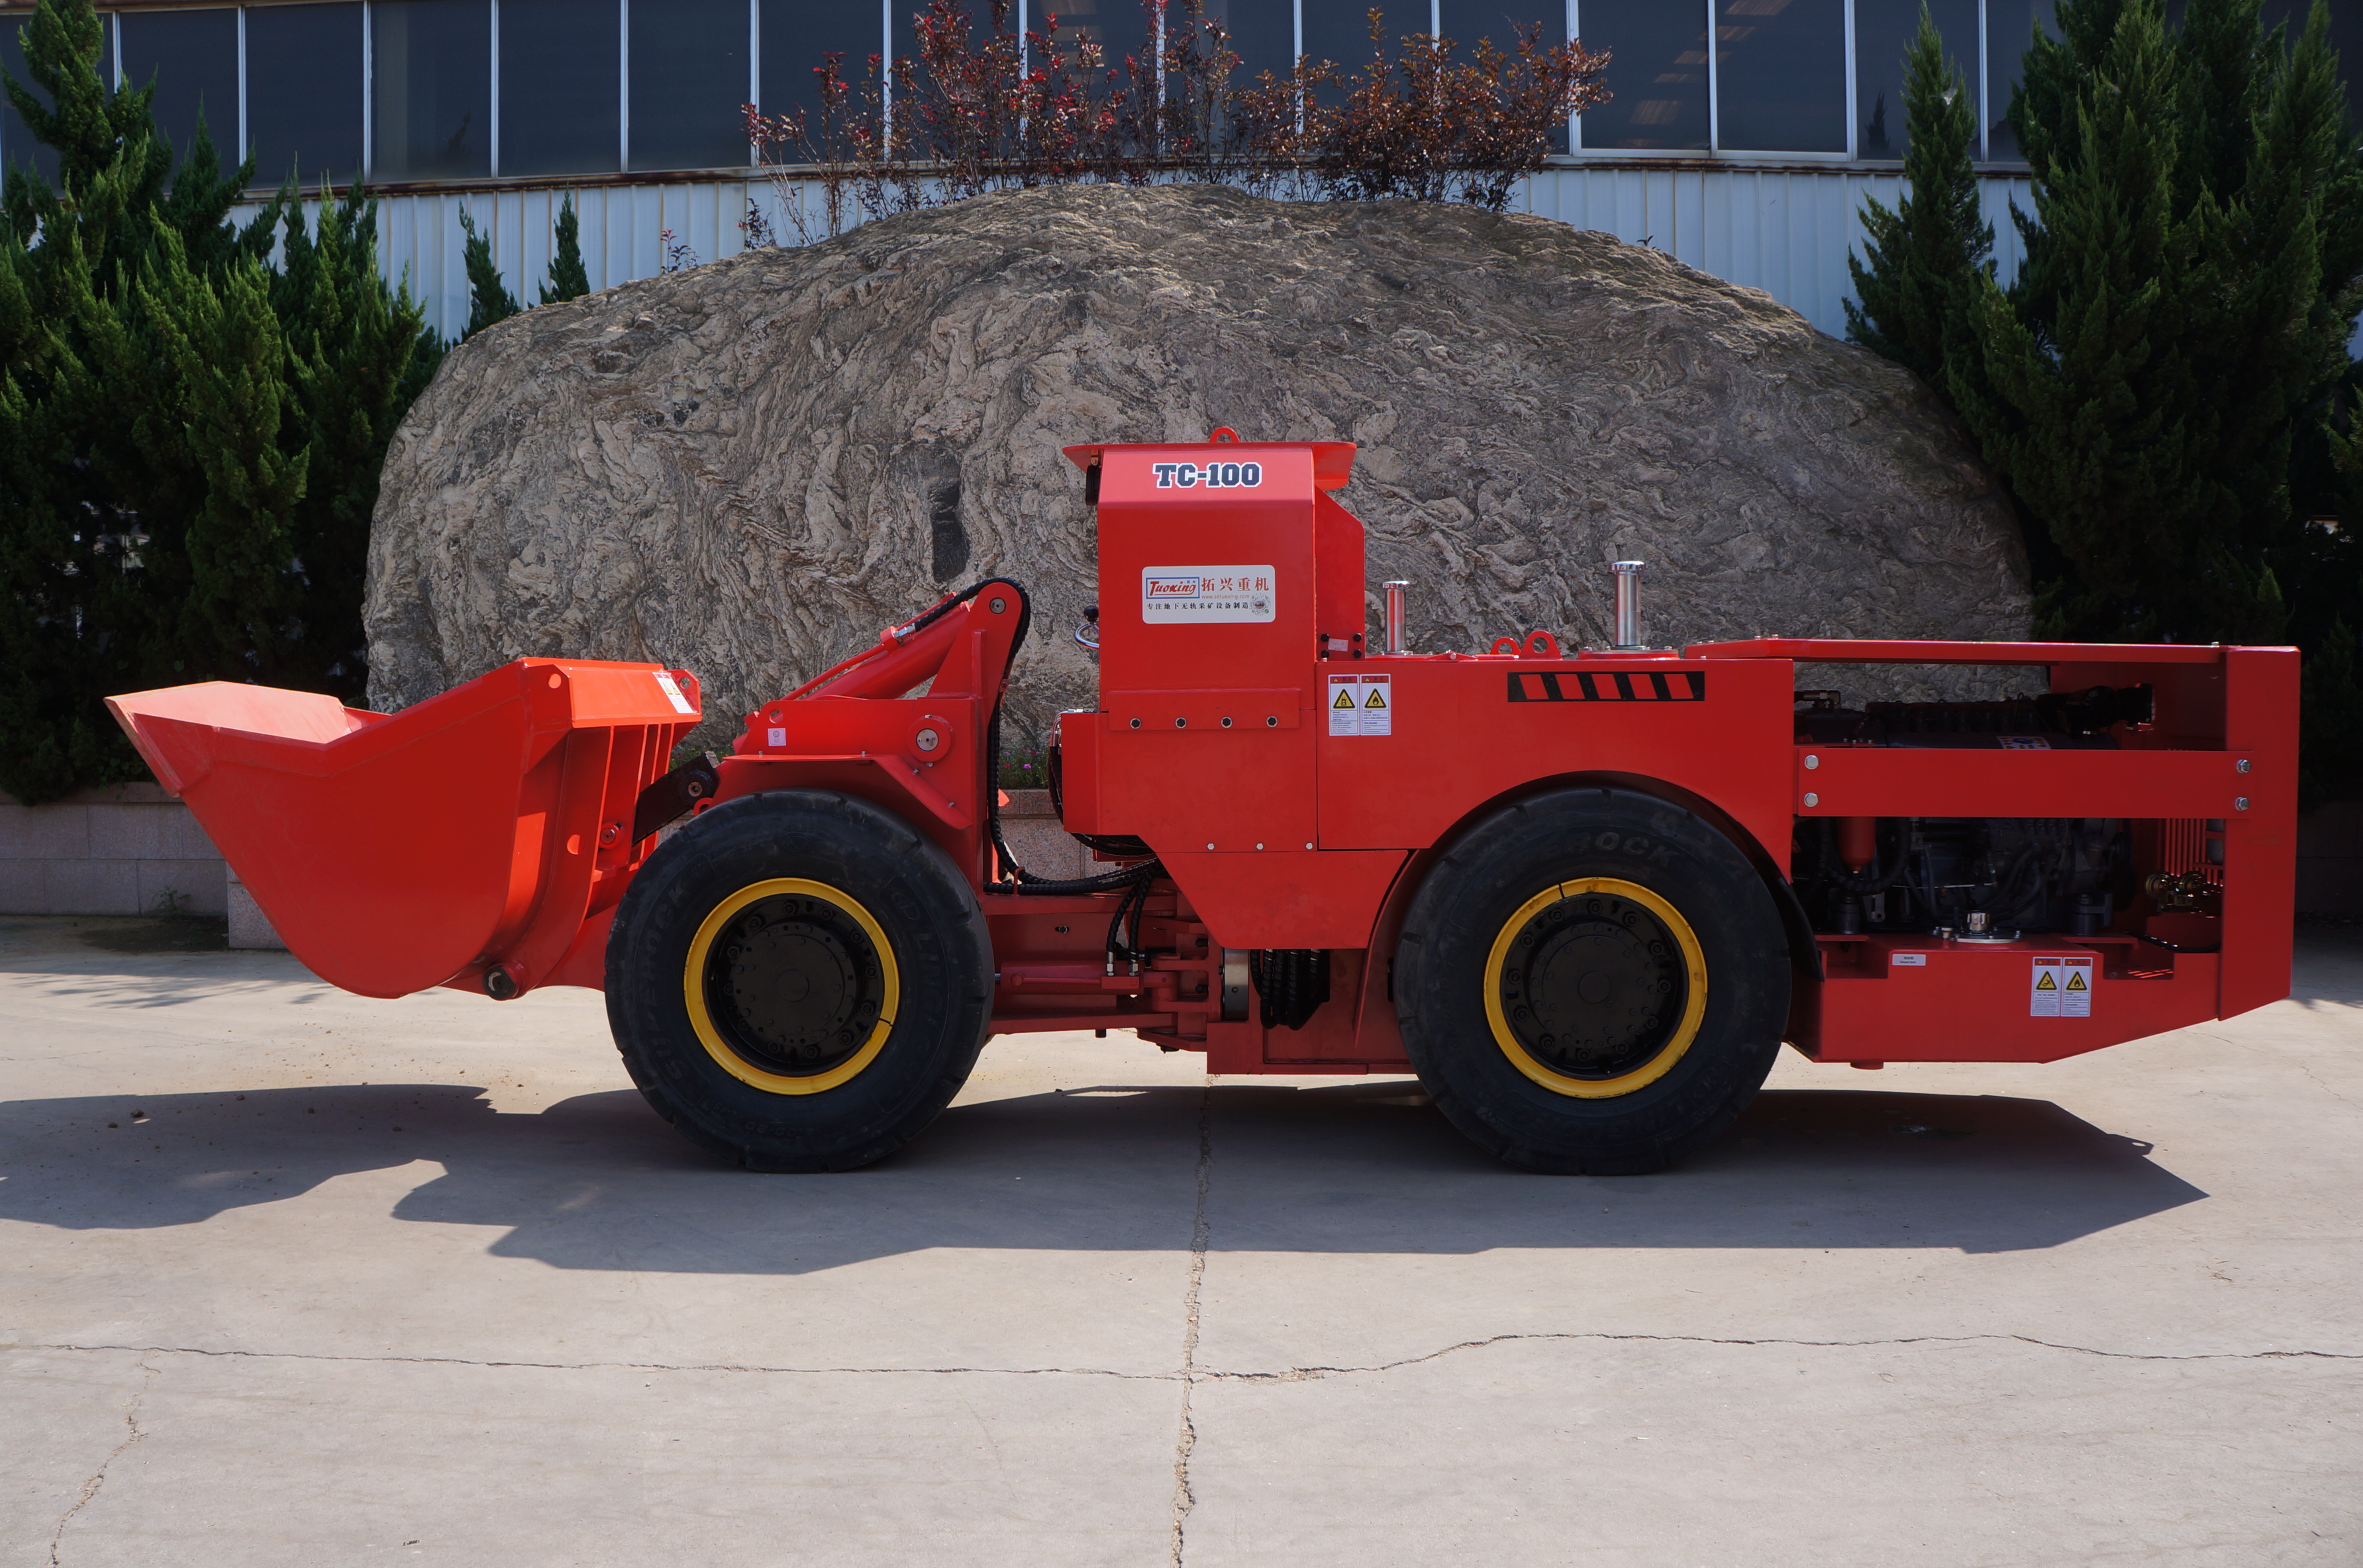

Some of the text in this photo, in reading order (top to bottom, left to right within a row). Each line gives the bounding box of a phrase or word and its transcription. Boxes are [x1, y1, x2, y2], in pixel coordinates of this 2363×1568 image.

[1153, 462, 1262, 489] TC-100
[1150, 581, 1197, 596] Tuoxing
[1201, 577, 1270, 592] 拓兴重机
[1146, 602, 1249, 611] 专注地下无轨采矿设备制造
